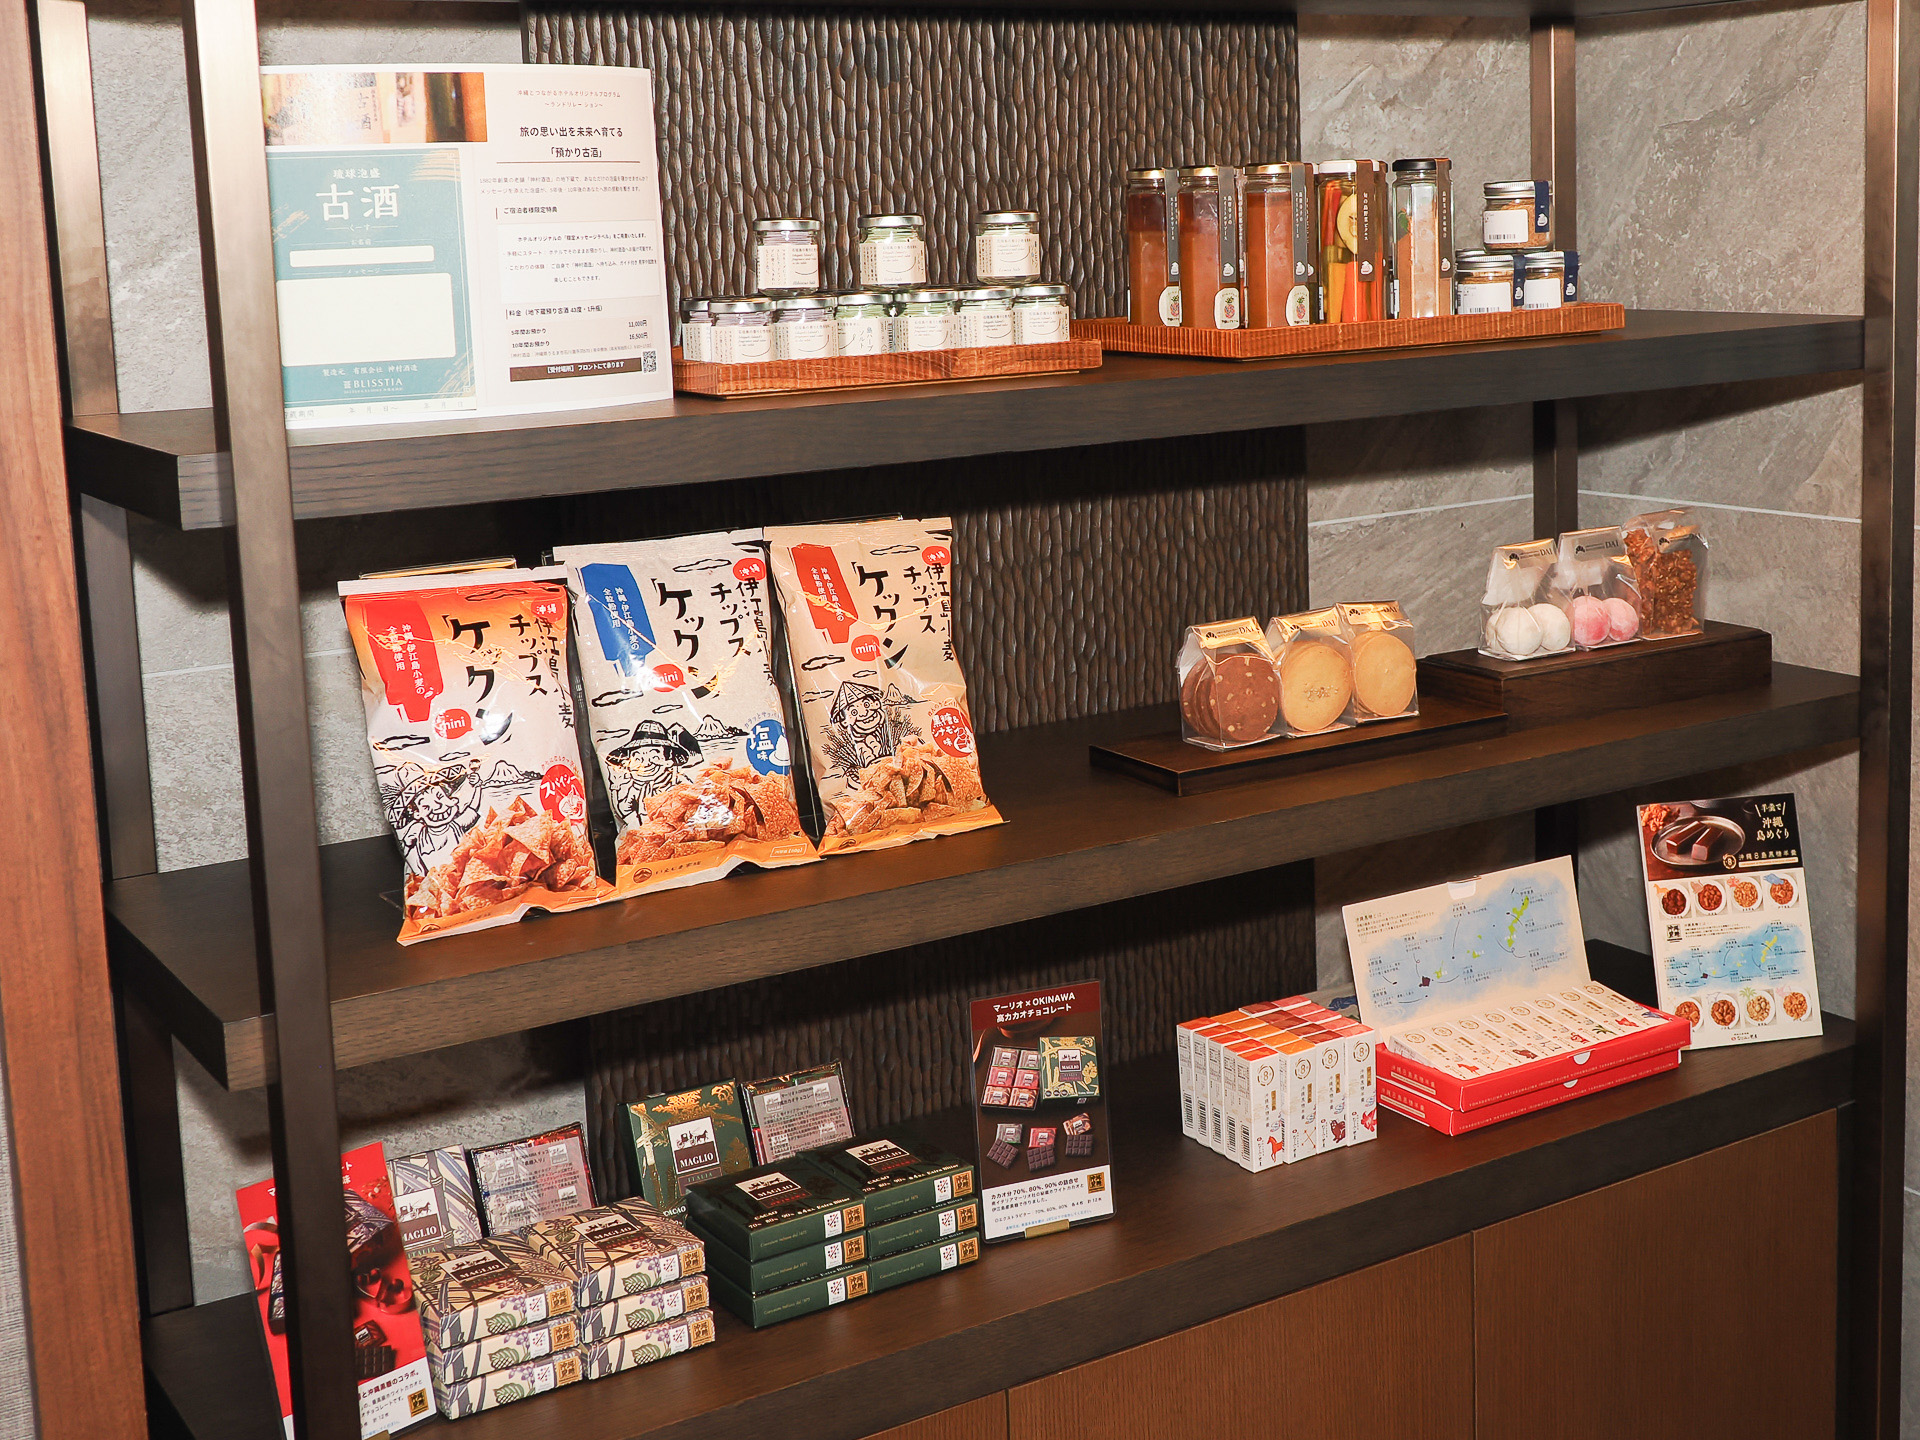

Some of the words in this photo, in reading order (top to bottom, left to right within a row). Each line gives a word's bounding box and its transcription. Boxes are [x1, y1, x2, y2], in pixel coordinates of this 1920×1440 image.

[520, 127, 623, 138] 旅の思い出を未来へ育てる
[551, 146, 602, 159] 「預かり古酒」
[333, 168, 381, 179] 琉球泡盛
[316, 183, 400, 220] 古酒
[503, 206, 558, 217] ご宿泊者様限定特典
[349, 224, 371, 232] くーす
[511, 328, 547, 336] 5年間お預かり
[512, 340, 551, 349] 10年間お預かり
[354, 366, 388, 375] 有限会社
[388, 364, 419, 374] 神村酒造
[354, 378, 404, 389] BLISSTIA
[927, 550, 946, 562] 沖縄
[739, 563, 762, 577] 沖縄
[903, 565, 937, 634] チップス
[536, 602, 558, 615] 沖縄
[924, 562, 955, 662] 伊江島小麦
[710, 582, 753, 659] チップス
[508, 613, 549, 697] チップス
[855, 641, 878, 656] mini
[942, 737, 954, 747] 味
[540, 775, 578, 799] スパイシー
[1762, 816, 1784, 829] 沖縄
[1756, 828, 1790, 842] 島めぐり
[996, 1003, 1072, 1023] 高カカオチョコレート
[679, 1152, 714, 1168] MAGLIO
[868, 1150, 903, 1163] MAGLIO
[687, 1172, 713, 1183] ITALIA
[867, 1175, 890, 1185] CACAO
[757, 1184, 794, 1198] MAGLIO
[754, 1210, 778, 1222] CACAO
[594, 1227, 632, 1239] MAGLIO
[408, 1247, 436, 1259] ITALIA
[459, 1264, 500, 1278] MAGLIO
[358, 1369, 419, 1402] と沖縄黒糖のコラボ。
